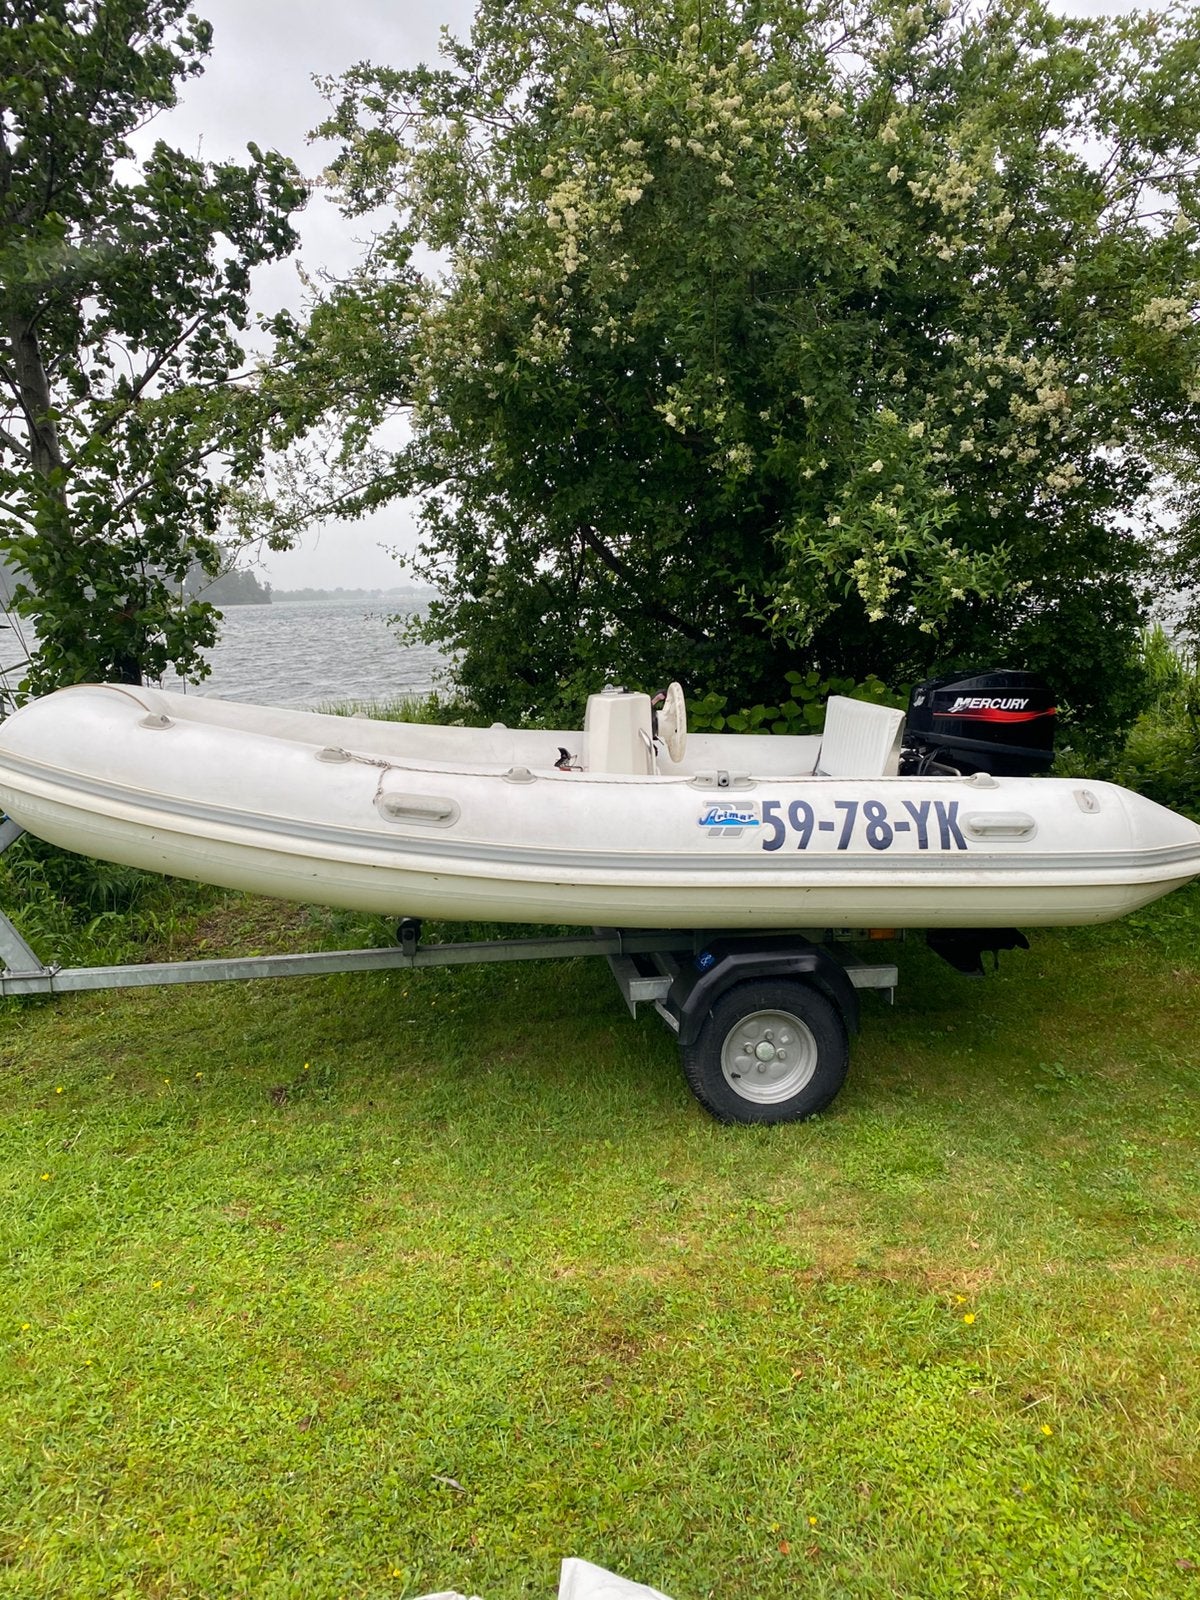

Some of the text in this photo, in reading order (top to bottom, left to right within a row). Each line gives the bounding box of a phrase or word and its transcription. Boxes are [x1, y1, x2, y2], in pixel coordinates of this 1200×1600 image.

[948, 697, 1029, 713] MERCURY
[699, 808, 754, 825] Arimar
[762, 800, 968, 851] 59-78-YK
